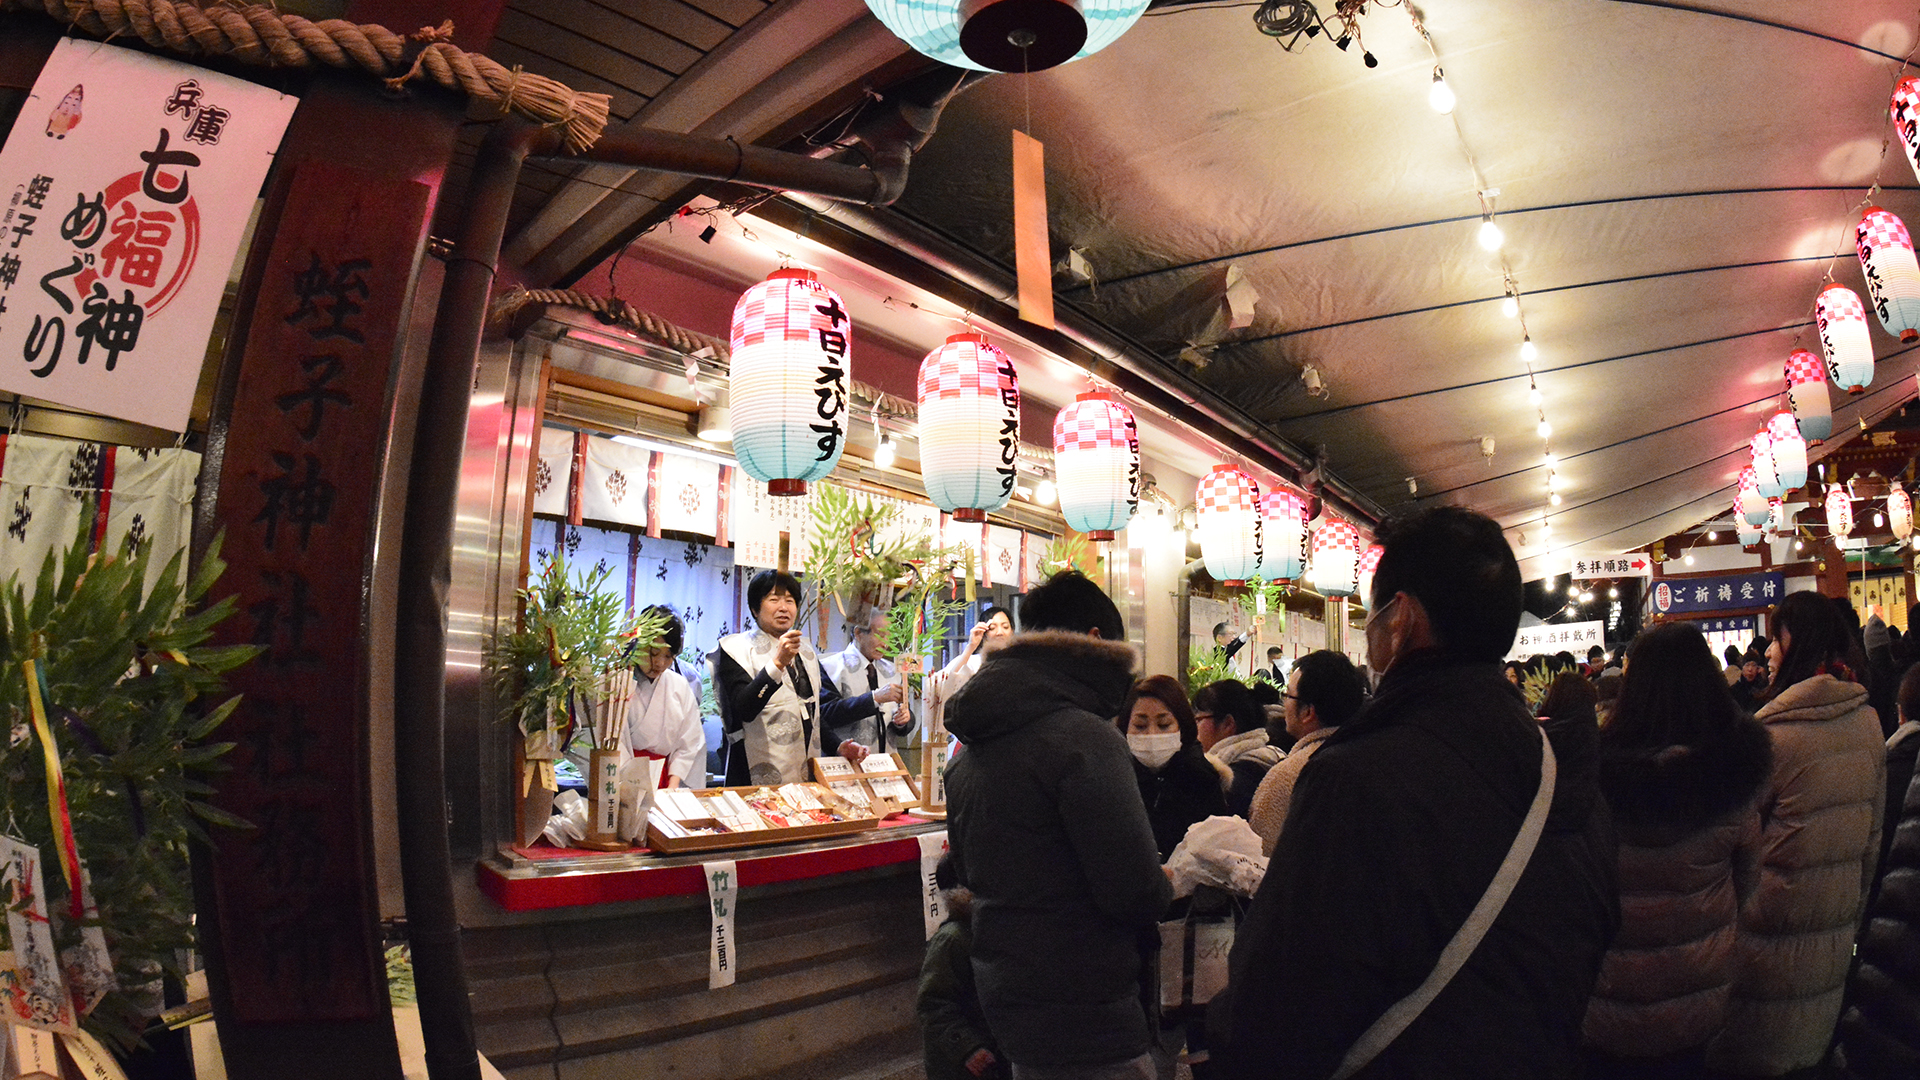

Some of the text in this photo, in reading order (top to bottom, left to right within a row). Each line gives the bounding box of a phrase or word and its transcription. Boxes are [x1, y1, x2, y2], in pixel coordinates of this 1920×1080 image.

[165, 79, 230, 145] 兵庫
[0, 174, 54, 333] 蛭子神
[23, 192, 107, 378] めぐり
[75, 128, 200, 372] 七福神
[809, 297, 849, 462] 十日えびす
[996, 359, 1020, 498] 十日えびす
[1576, 559, 1630, 575] 参拝順路
[1658, 585, 1670, 609] 招福
[1674, 580, 1776, 604] ご祈祷受付
[605, 763, 617, 794] 竹札
[711, 870, 729, 972] 竹札 千三百円
